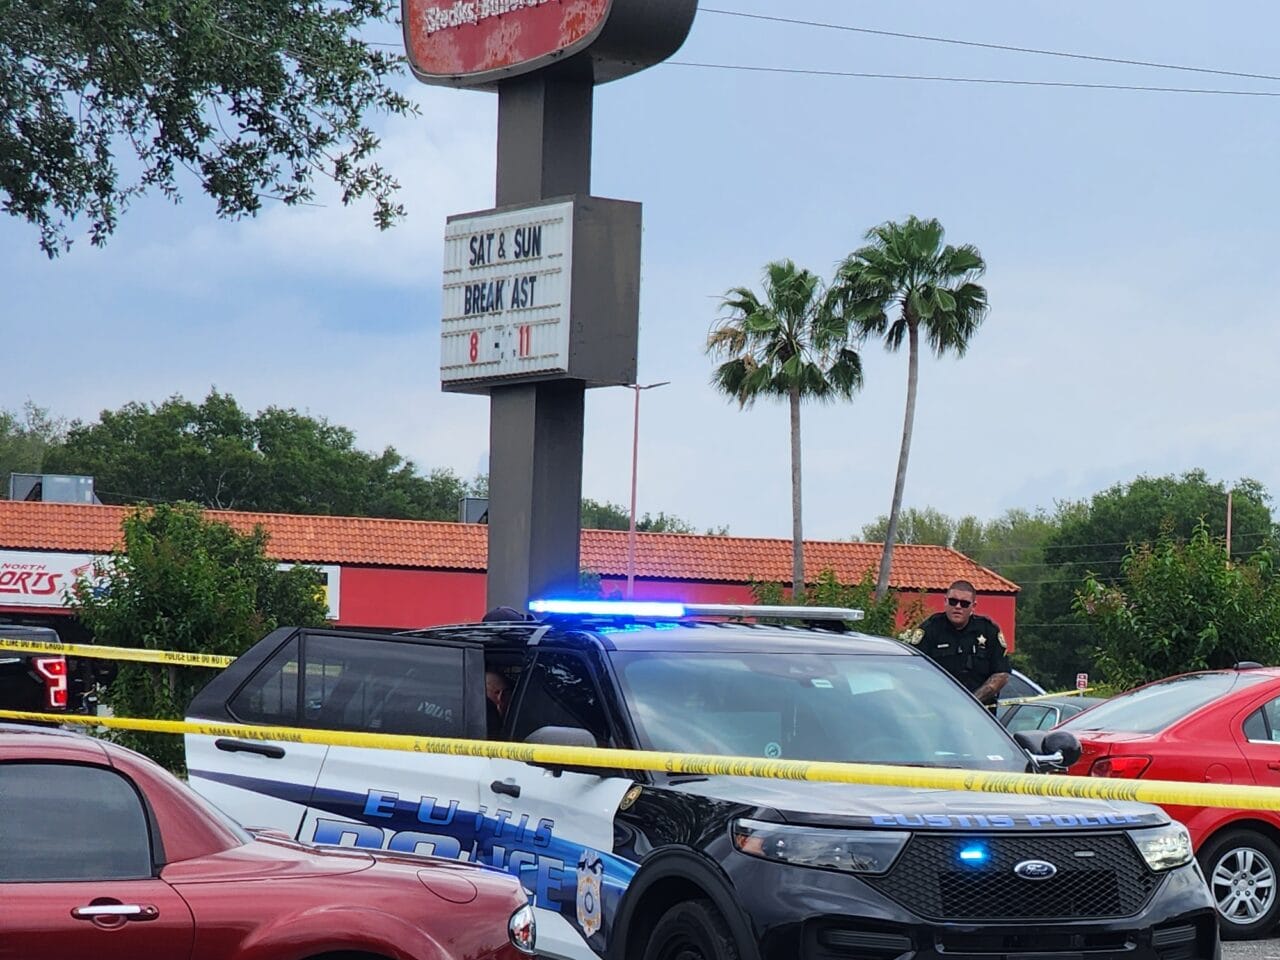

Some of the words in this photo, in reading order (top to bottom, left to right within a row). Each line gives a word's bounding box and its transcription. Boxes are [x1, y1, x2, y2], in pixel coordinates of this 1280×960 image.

[469, 233, 494, 266] SAT
[498, 232, 506, 259] &
[514, 225, 541, 259] SUN
[470, 331, 478, 362] 8
[520, 325, 530, 356] 11
[870, 813, 1016, 828] EUSTIS
[1025, 812, 1141, 827] POLICE
